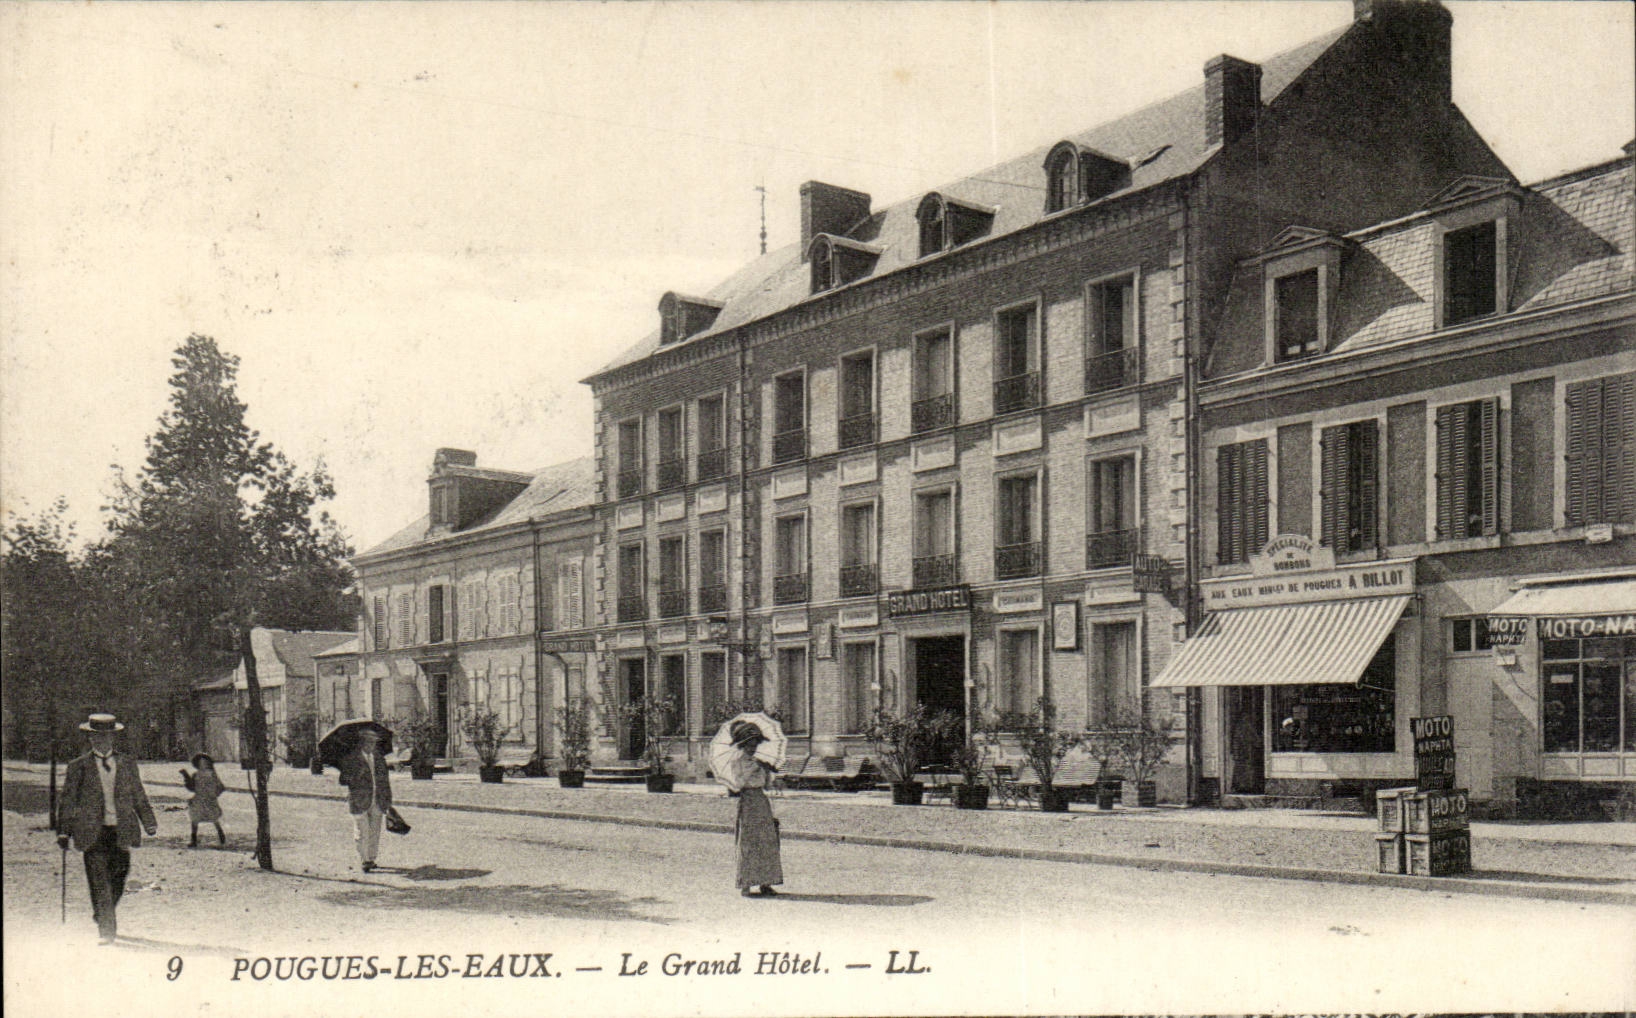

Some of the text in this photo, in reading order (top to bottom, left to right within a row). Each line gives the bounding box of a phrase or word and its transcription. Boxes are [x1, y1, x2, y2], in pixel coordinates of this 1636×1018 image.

[1135, 555, 1161, 572] AUTO
[1273, 559, 1311, 571] BONBONS
[1211, 590, 1226, 600] AUX
[1231, 587, 1253, 598] EAUX
[1288, 583, 1299, 593] DE
[1304, 578, 1342, 592] POUGUES
[1362, 570, 1404, 588] BILLOT
[890, 593, 928, 614] GRAND
[1415, 716, 1451, 739] MOTO
[1418, 739, 1452, 754] NAPHTA
[1431, 795, 1466, 817] MOTO
